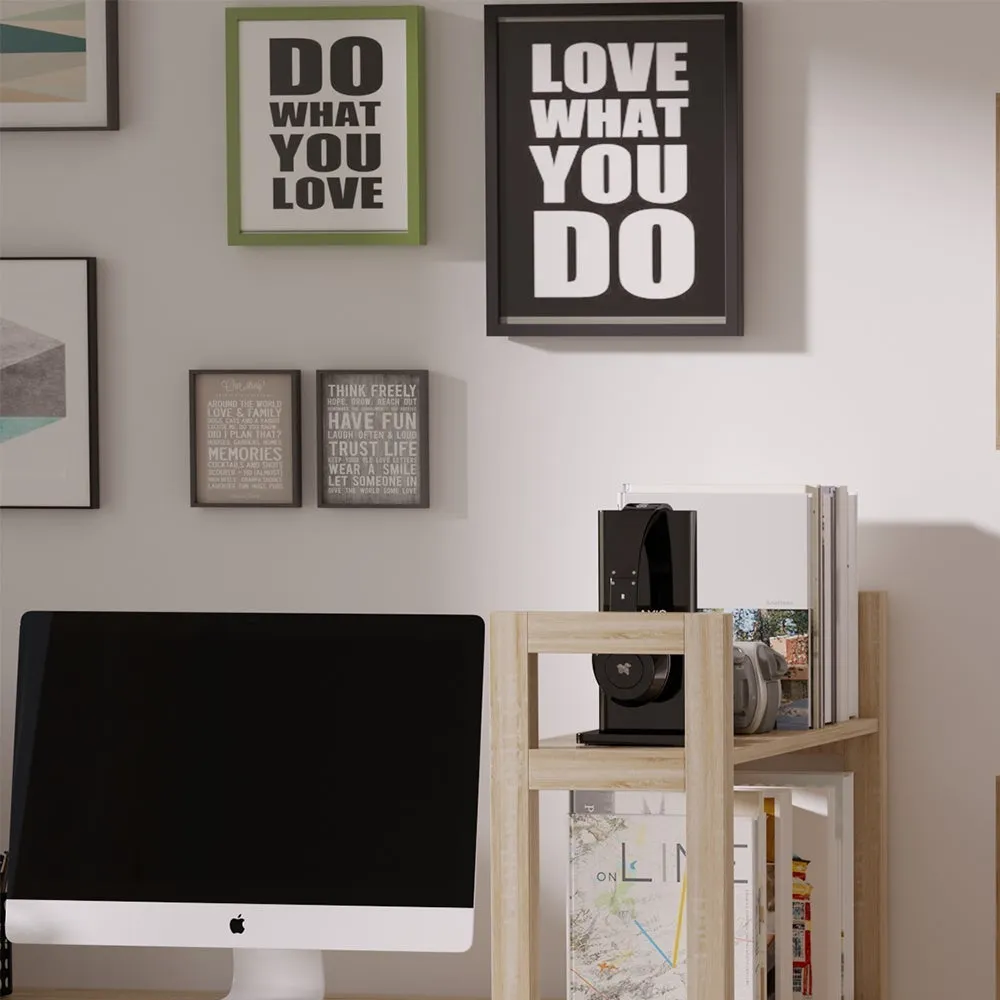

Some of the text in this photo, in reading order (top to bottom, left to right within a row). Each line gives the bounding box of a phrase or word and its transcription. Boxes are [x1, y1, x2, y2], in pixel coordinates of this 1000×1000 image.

[269, 36, 384, 97] DO
[531, 42, 689, 94] LOVE
[270, 102, 381, 128] WHAT
[530, 99, 689, 139] WHAT
[271, 133, 382, 173] YOU
[529, 143, 688, 205] YOU
[273, 177, 384, 211] LOVE
[533, 208, 696, 300] DO
[328, 384, 417, 397] THINK FREELY
[208, 400, 282, 408] AROUND THE WORLD
[403, 398, 417, 406] OUT
[208, 408, 282, 418] LOVE & FAMILY
[328, 412, 417, 430] HAVE FUN
[208, 430, 220, 439] DID
[230, 430, 252, 439] PLAN
[257, 430, 282, 439] THAT?
[328, 431, 417, 440] LAUGH OFTEN & LOUD
[208, 447, 282, 461] MEMORIES
[328, 441, 418, 457] TRUST LIFE
[328, 463, 417, 475] WEAR A SMILE
[328, 475, 417, 487] LET SOMEONE IN
[346, 487, 356, 495] THE
[360, 487, 379, 495] WORLD
[383, 487, 399, 495] SOME
[402, 487, 417, 495] LOVE
[596, 872, 617, 882] ON
